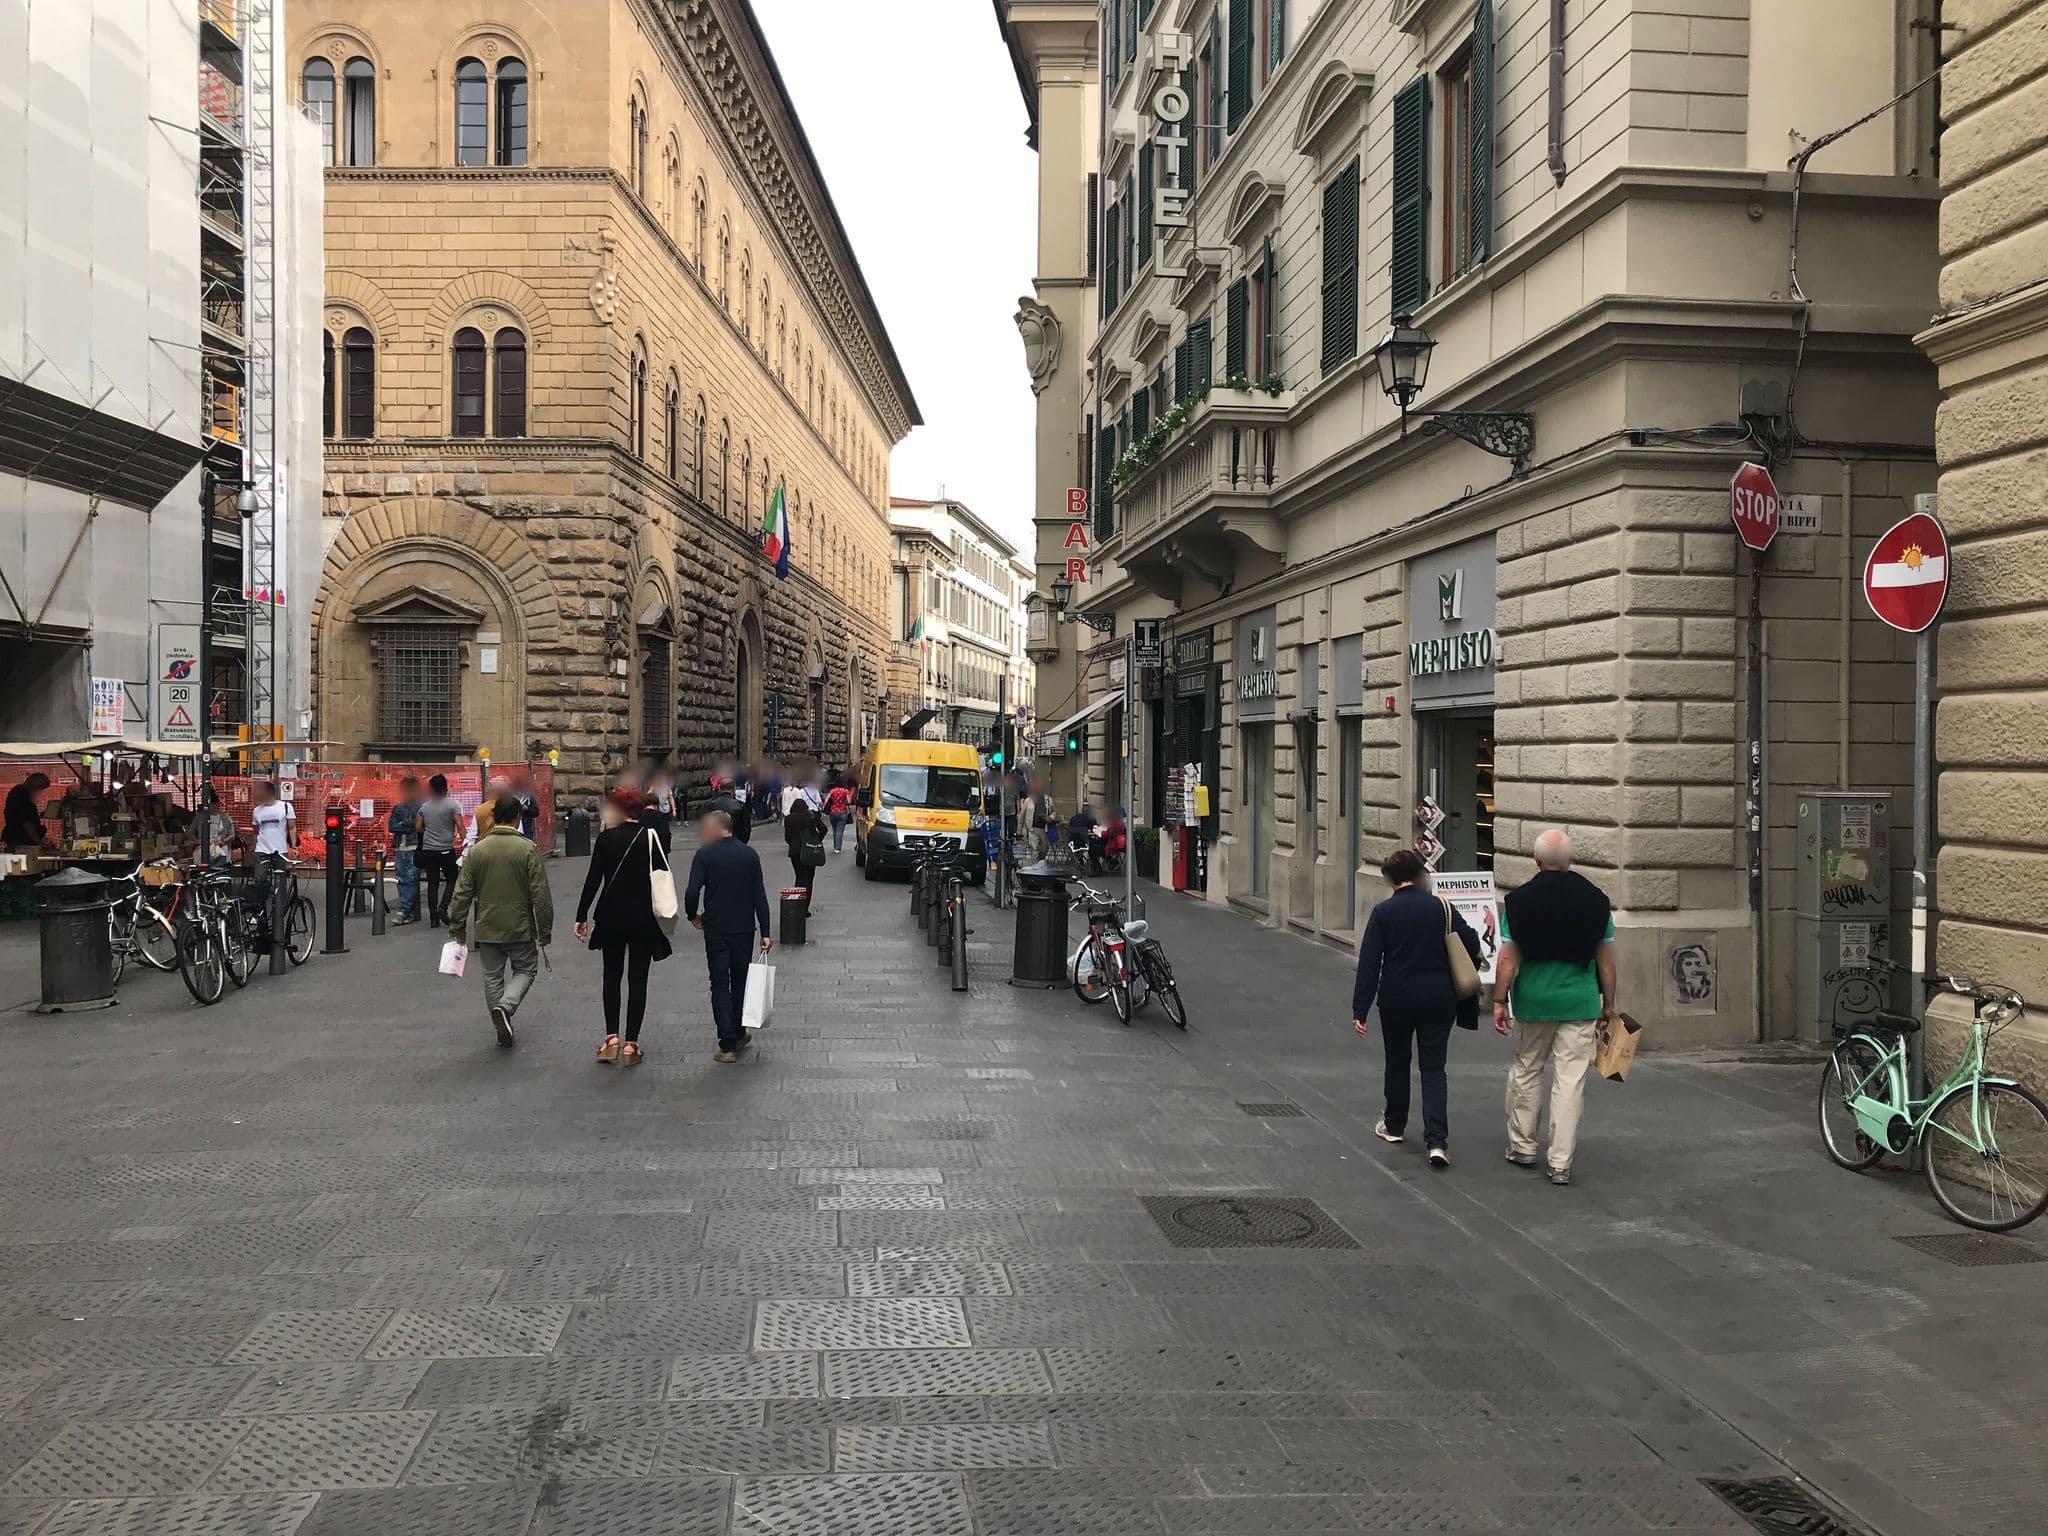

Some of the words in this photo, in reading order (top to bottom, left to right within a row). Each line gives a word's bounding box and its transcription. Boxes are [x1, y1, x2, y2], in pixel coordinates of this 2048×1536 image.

[1154, 33, 1190, 278] HOTEL
[1735, 486, 1776, 526] STOP
[1779, 500, 1804, 511] VIA
[1063, 487, 1089, 583] BAR
[1408, 628, 1493, 676] MEPHISTO
[171, 688, 188, 700] 20
[1237, 669, 1275, 698] MEPHISTO
[914, 816, 951, 825] DHL
[1437, 880, 1479, 890] MEPHISTO
